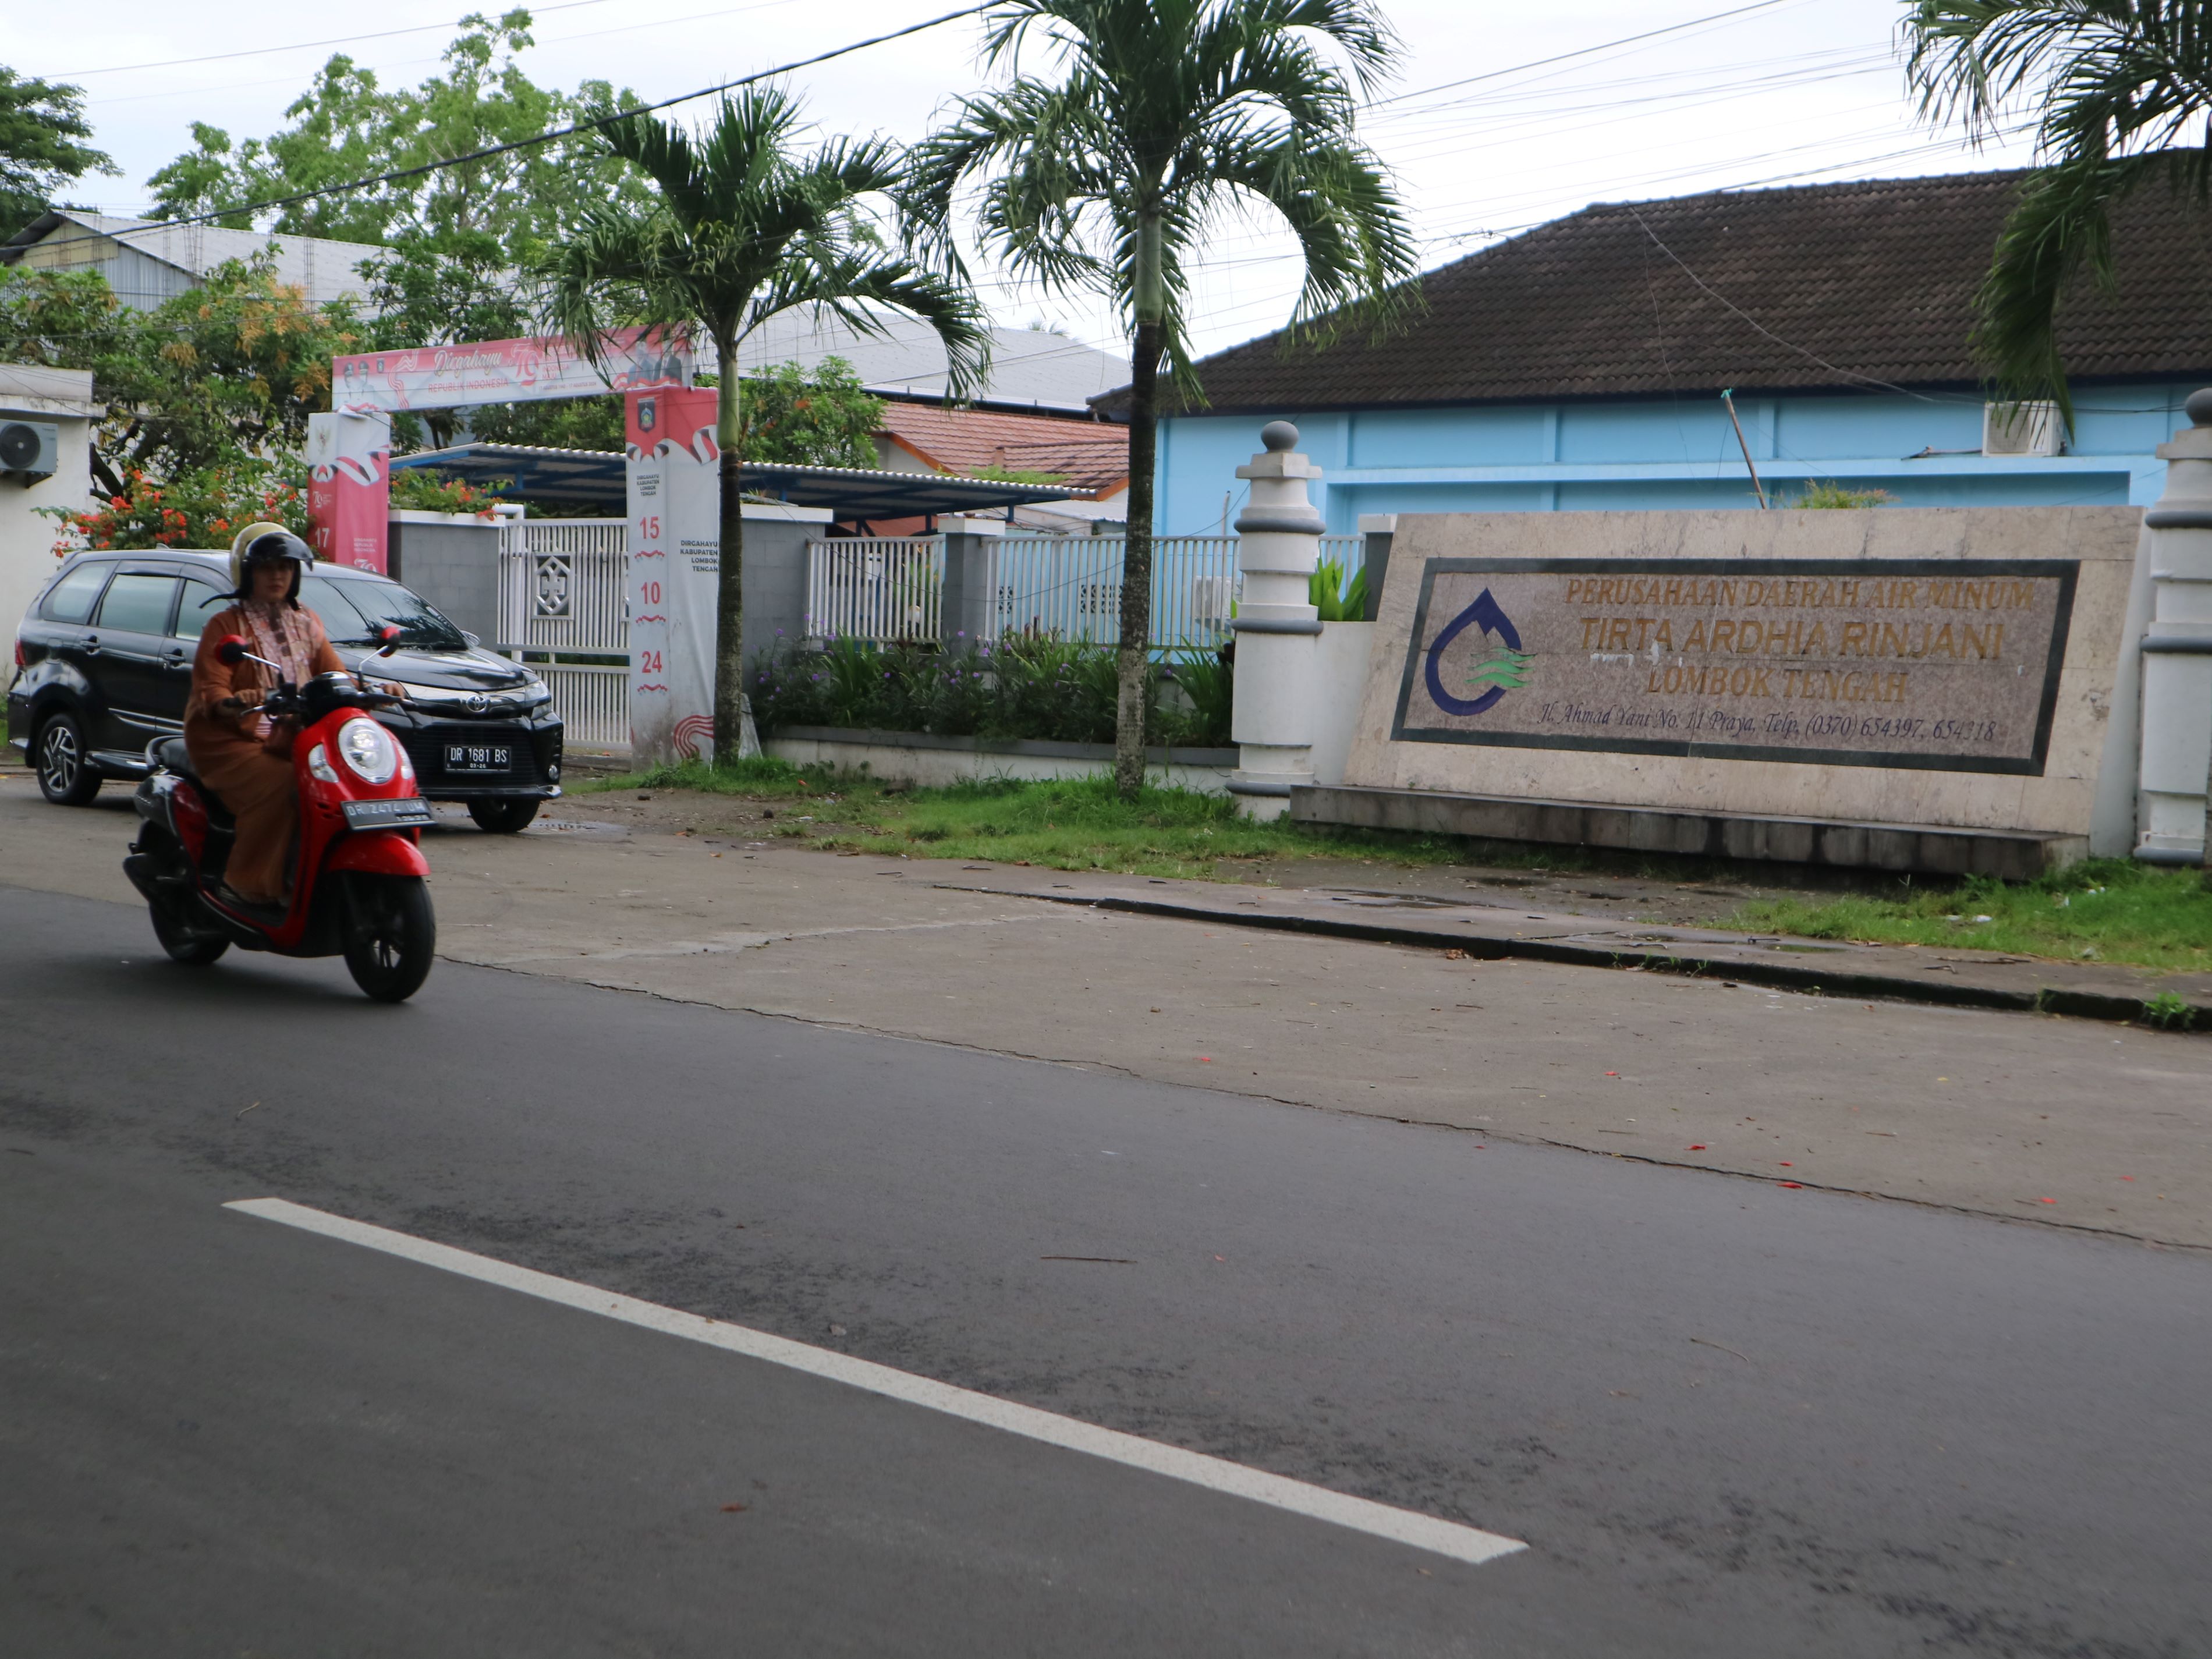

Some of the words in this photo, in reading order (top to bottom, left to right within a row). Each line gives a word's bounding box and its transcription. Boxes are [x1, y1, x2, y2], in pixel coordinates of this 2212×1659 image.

[434, 348, 504, 378] Dirgahayu
[428, 381, 464, 393] REPUBLIK
[466, 377, 509, 390] INDONESIA
[315, 527, 329, 548] 17
[640, 516, 660, 539] 15
[641, 582, 661, 604] 10
[1565, 578, 1738, 606] PERUSAHAAN
[1747, 580, 1862, 607] DAERAH
[1864, 581, 1917, 608] AIR
[1924, 582, 2034, 611] MINUM
[1580, 617, 1674, 651] TIRTA
[1681, 619, 1828, 655] ARDHIA
[1839, 621, 2005, 660] RINJANI
[641, 650, 662, 673] 24
[1646, 665, 1775, 697] LOMBOK
[1784, 668, 1908, 702] TENGAH
[1537, 702, 1554, 724] Jl.
[1558, 704, 1614, 725] Ahmad
[1616, 706, 1653, 728] Yani
[1653, 708, 1679, 729] No.
[1709, 711, 1756, 737] Praya,
[1764, 711, 1800, 739] Telp.
[1806, 712, 1858, 740] (0370)
[451, 747, 463, 761] DR
[468, 747, 490, 762] 1681
[495, 749, 507, 763] BS
[346, 804, 364, 816] DR
